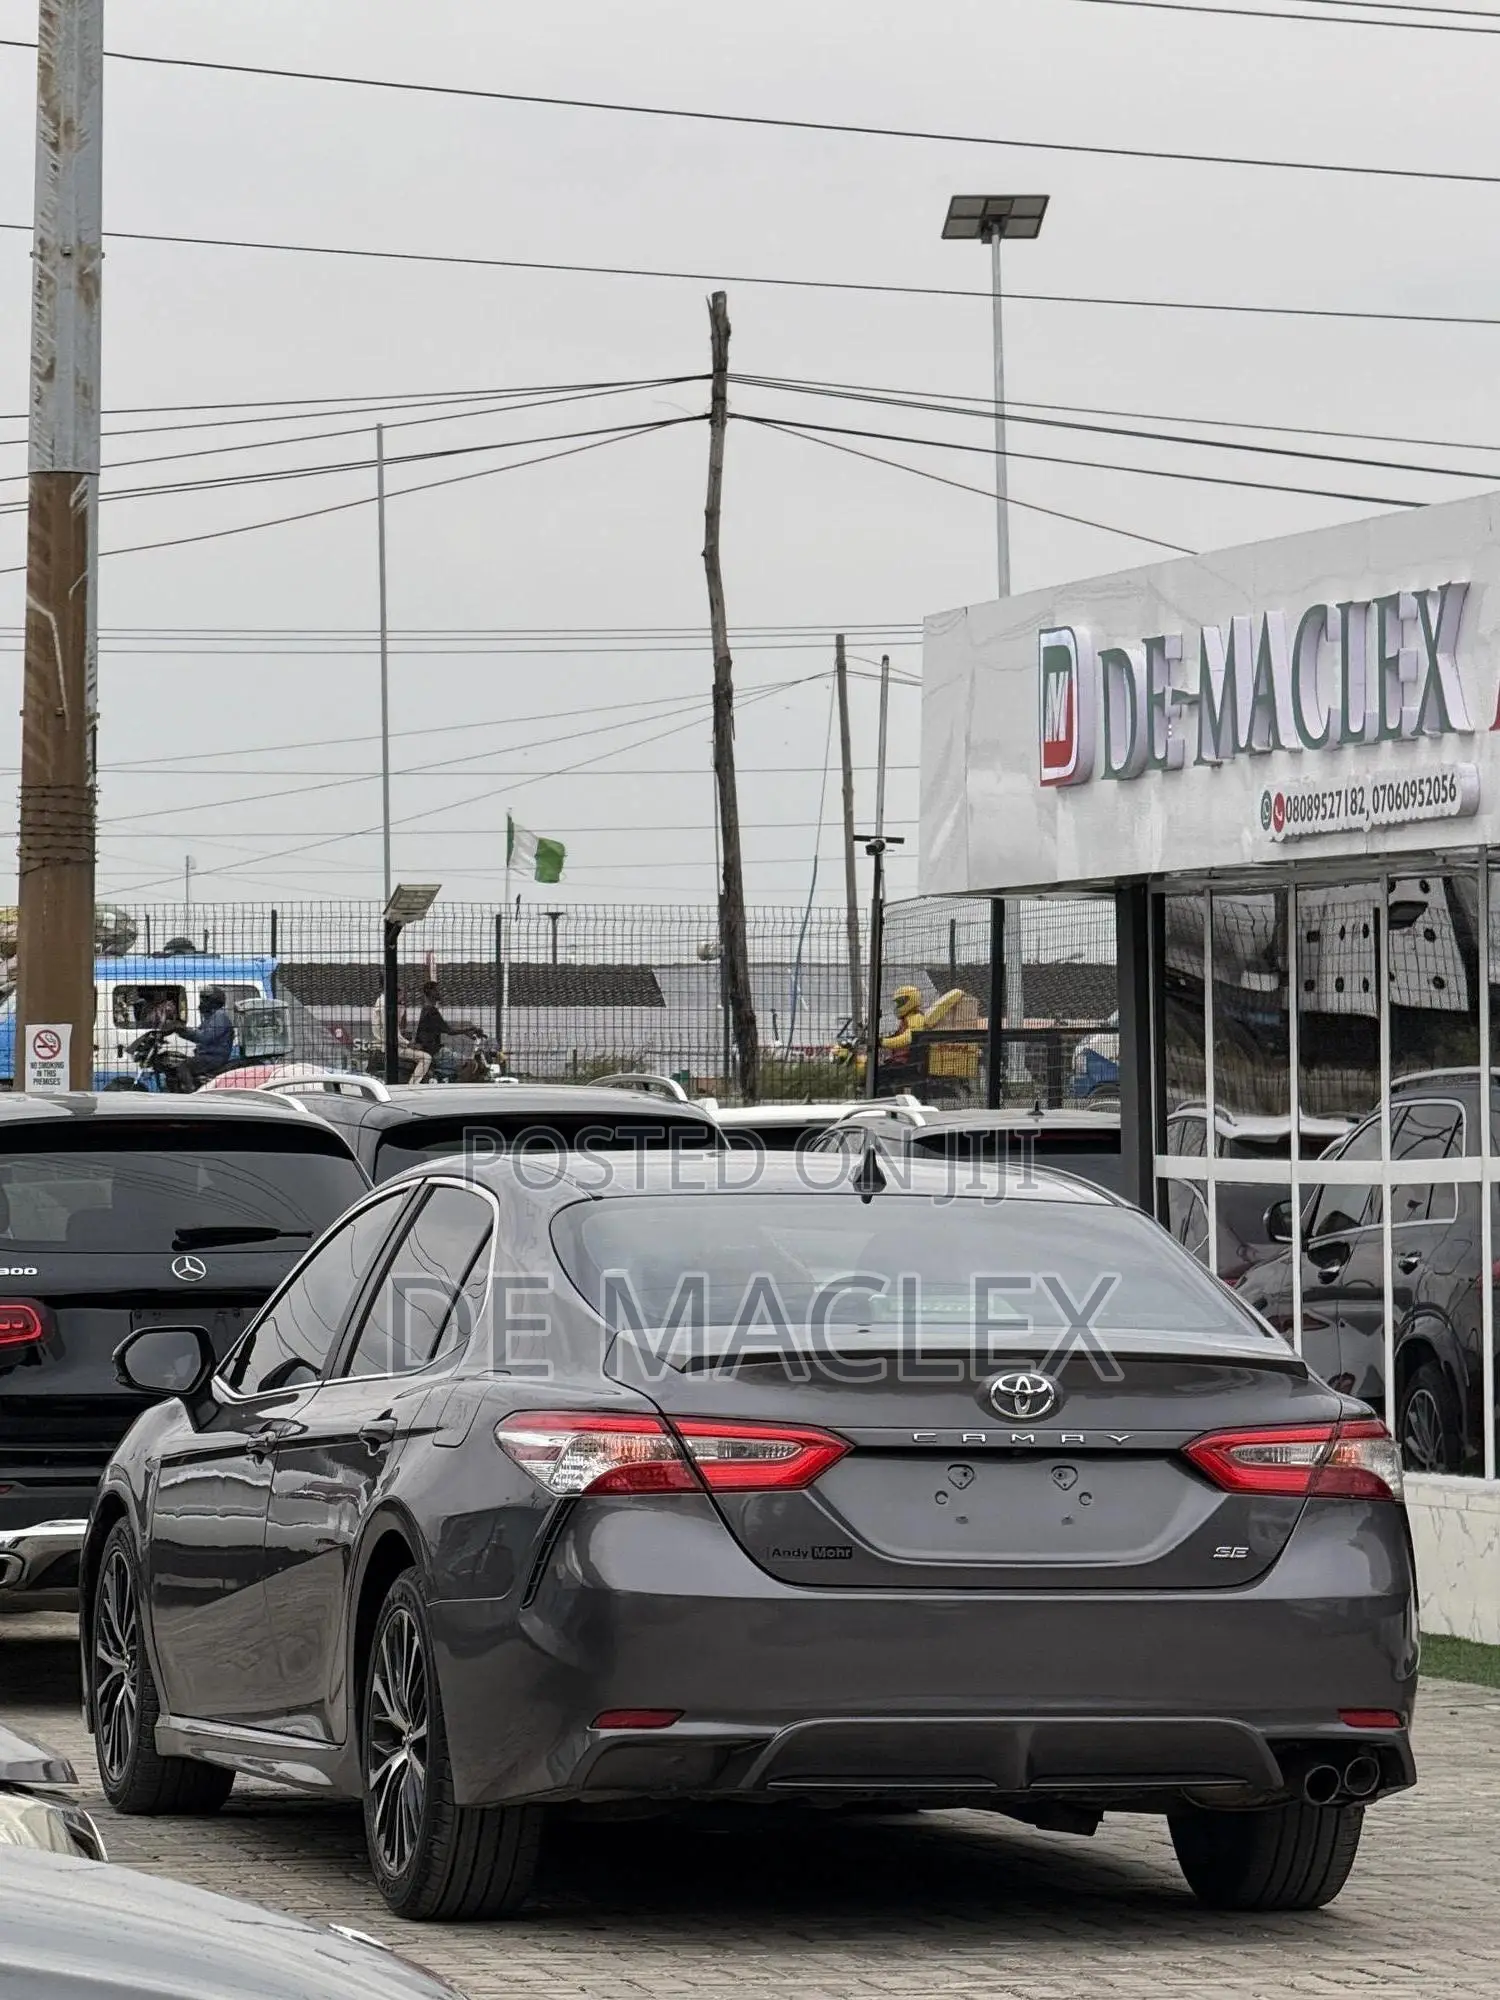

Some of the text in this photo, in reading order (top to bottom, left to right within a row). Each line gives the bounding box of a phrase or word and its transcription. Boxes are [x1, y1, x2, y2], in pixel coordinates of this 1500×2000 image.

[1285, 774, 1457, 823] 08089527182, 07060952056
[38, 1061, 65, 1069] SMOKING
[36, 1069, 57, 1078] IN THIS
[33, 1077, 61, 1086] PREMISES
[912, 1432, 1135, 1445] CAMRY
[771, 1547, 851, 1559] Andy Mohr
[1213, 1546, 1250, 1558] SE
